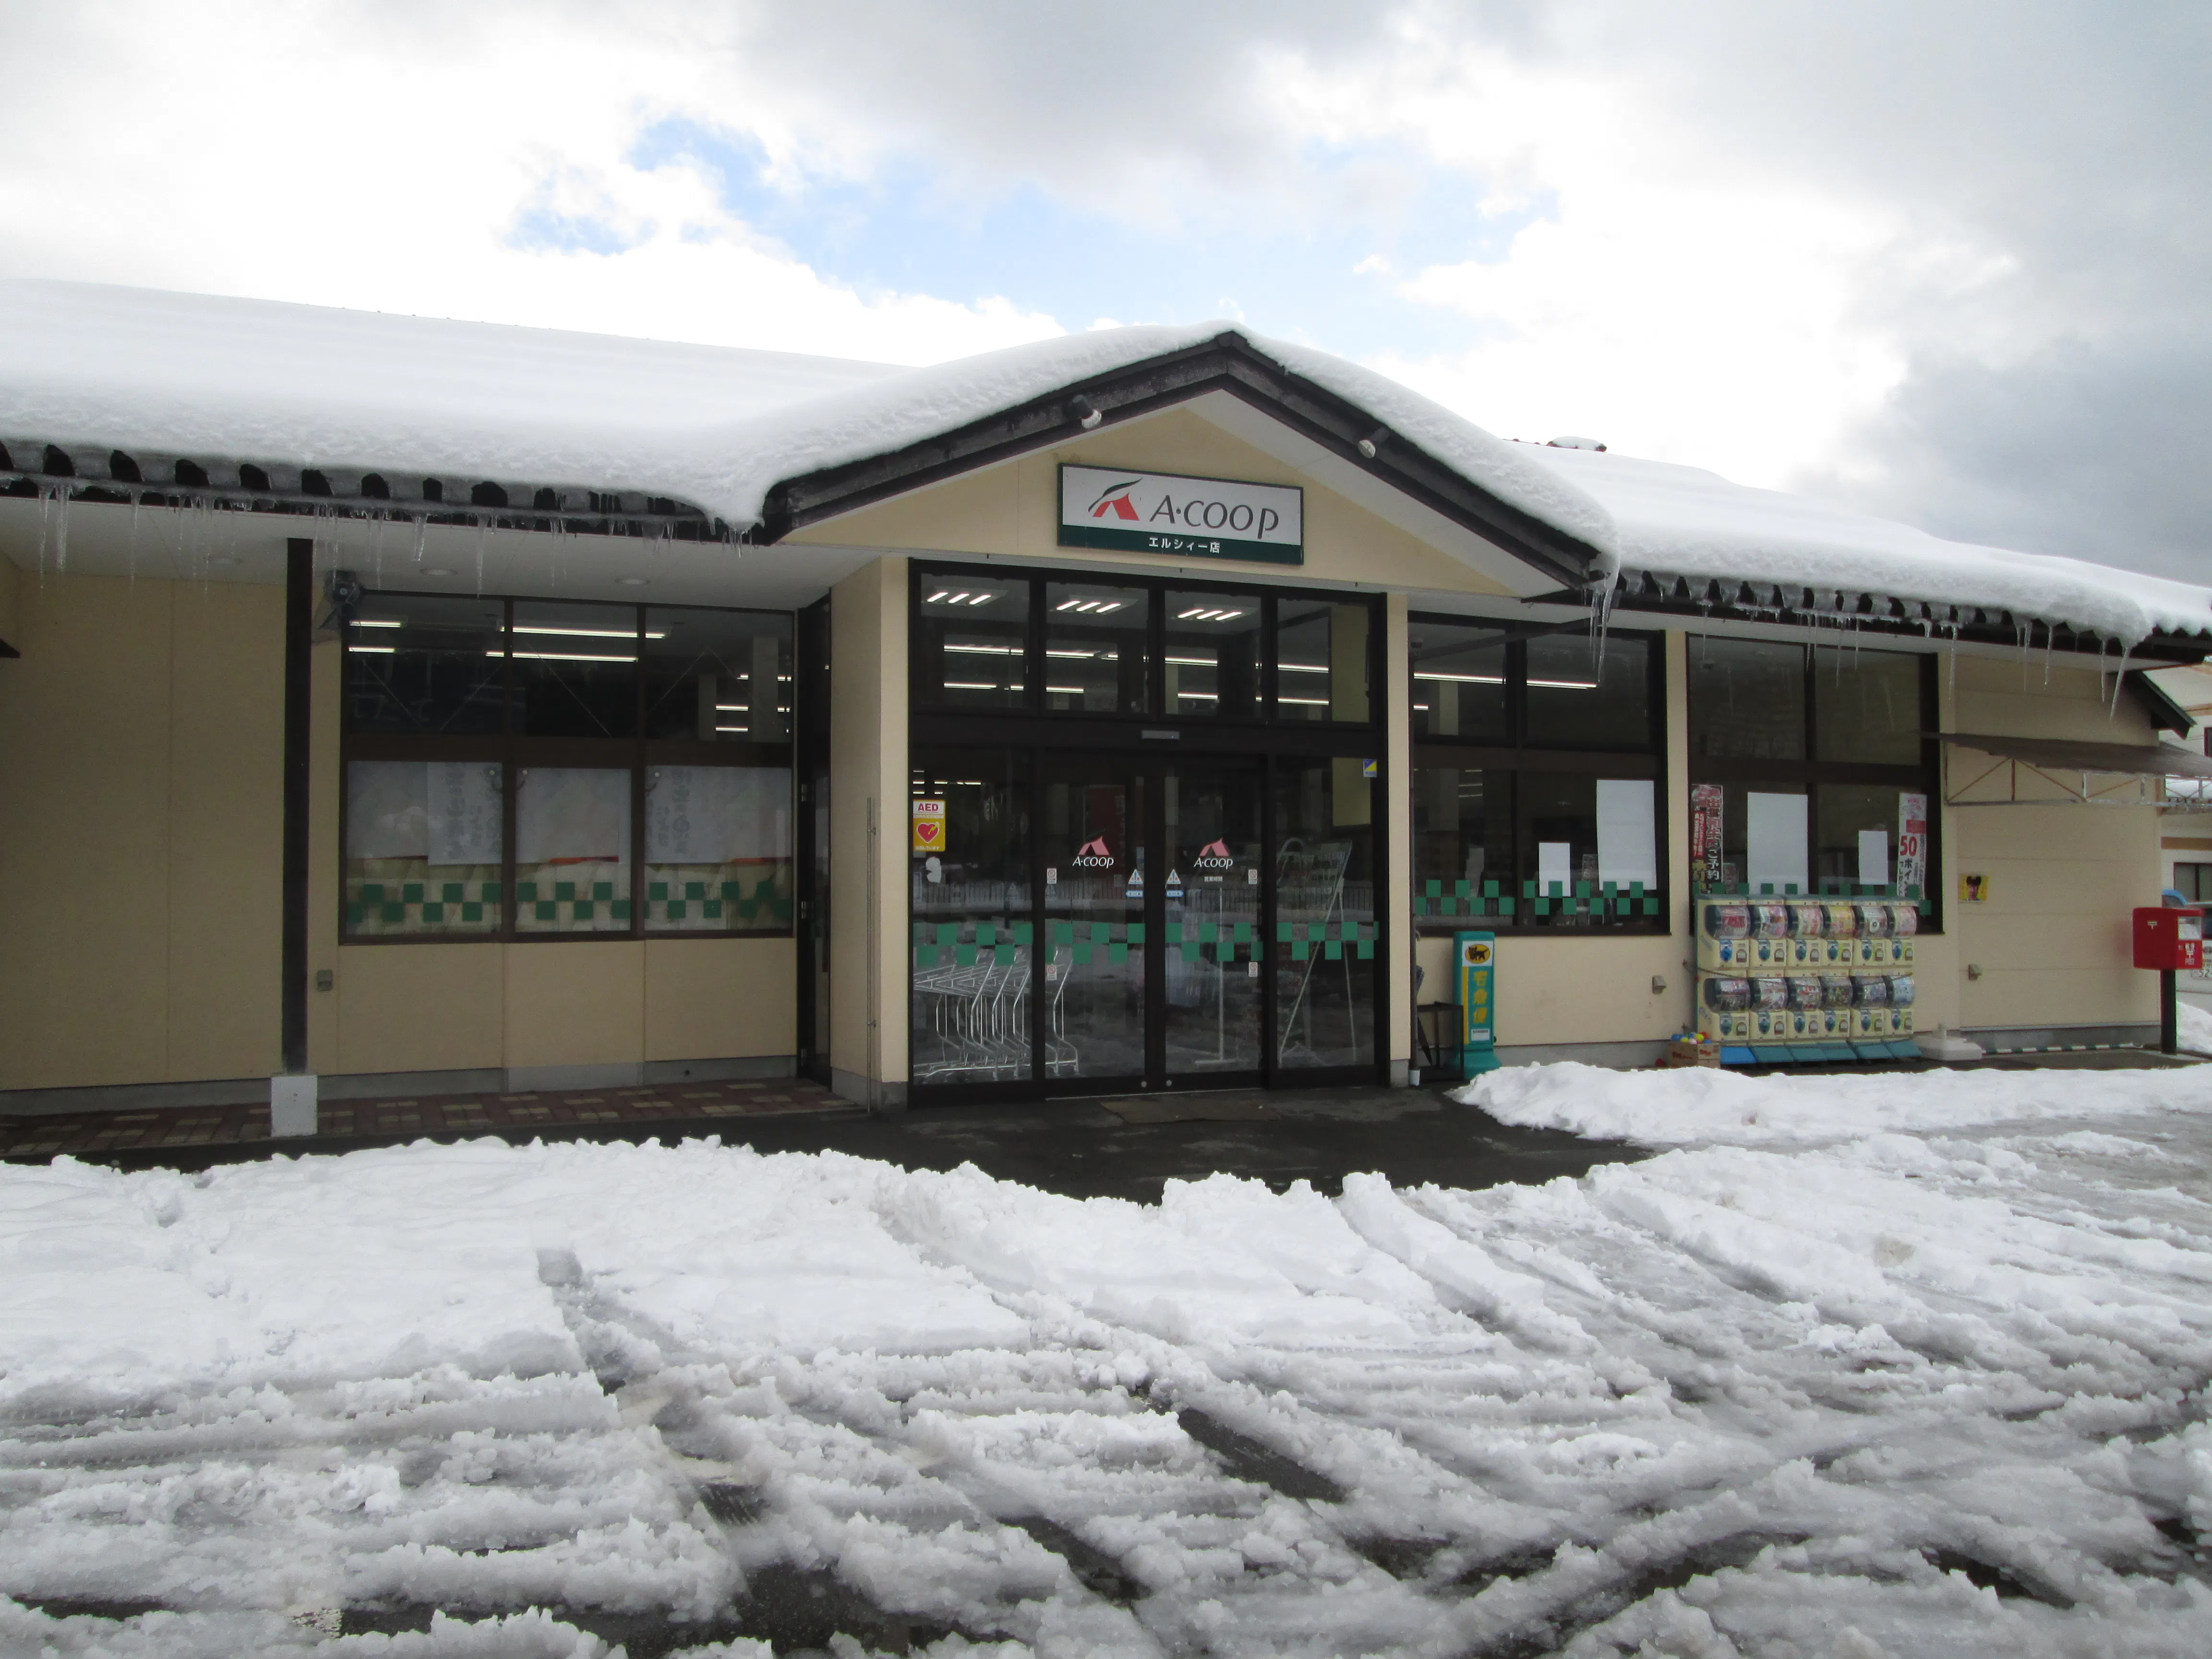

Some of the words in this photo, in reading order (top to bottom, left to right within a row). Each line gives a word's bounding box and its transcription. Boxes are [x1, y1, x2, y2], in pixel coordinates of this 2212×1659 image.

[1149, 537, 1221, 553] エルシィー店
[918, 803, 939, 811] AED
[1899, 835, 1917, 857] 50
